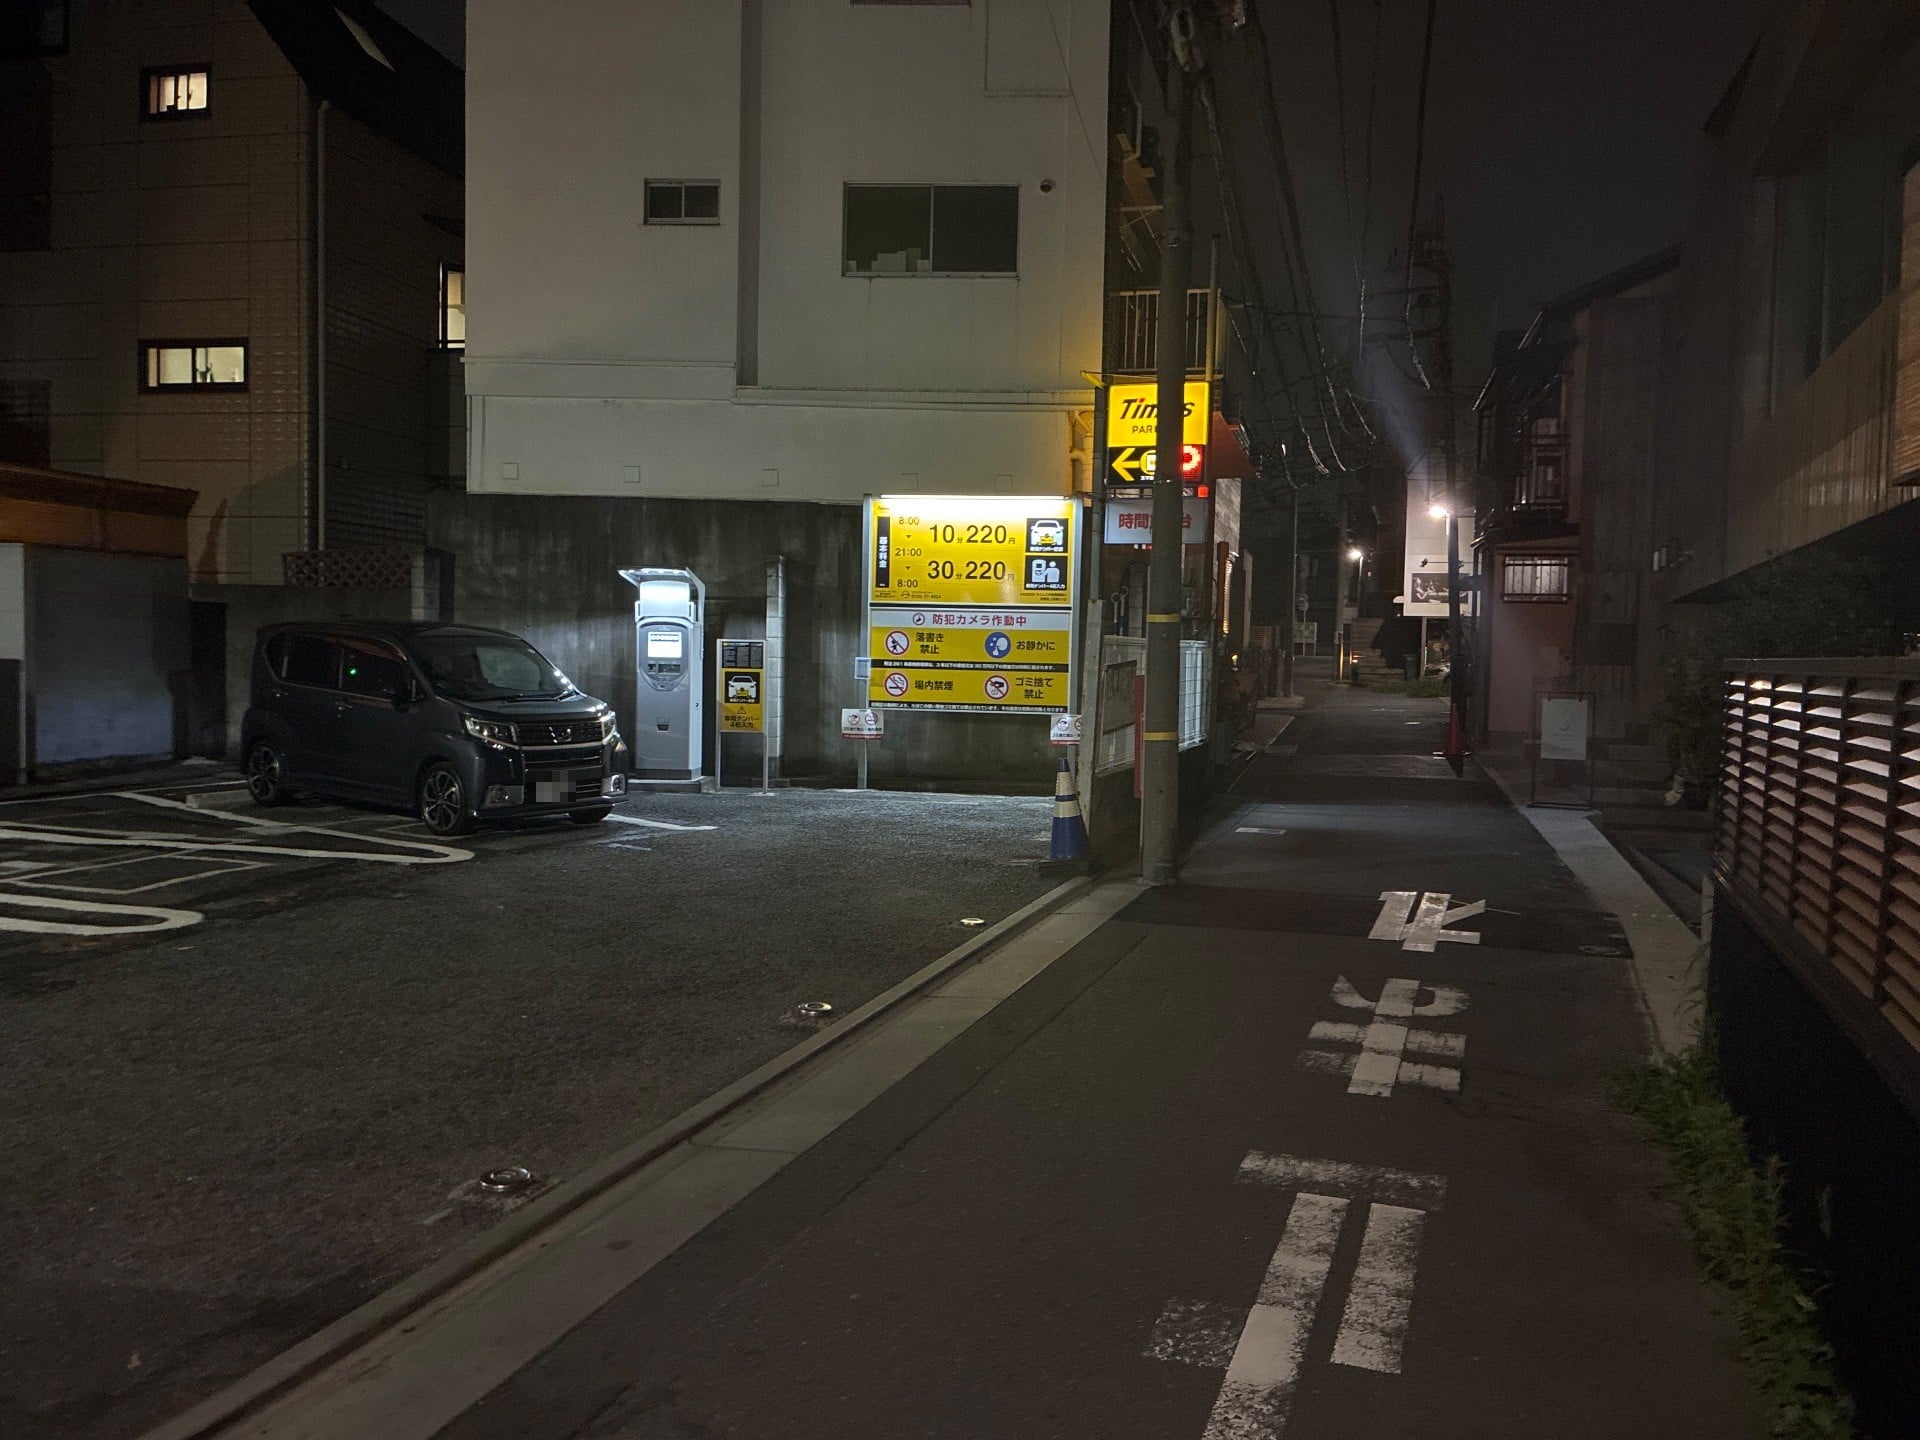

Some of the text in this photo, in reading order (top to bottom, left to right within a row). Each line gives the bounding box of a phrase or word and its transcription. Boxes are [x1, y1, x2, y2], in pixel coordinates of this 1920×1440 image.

[1120, 397, 1196, 420] Tims
[898, 516, 920, 526] 8:00
[1119, 514, 1192, 529] 時間台
[895, 548, 922, 557] 21:00
[897, 579, 919, 588] 8:00
[932, 614, 1028, 626] 防犯カメラ作動中
[915, 632, 945, 643] 落書き
[920, 644, 940, 655] 禁止
[1016, 640, 1056, 651] お静かに
[914, 680, 954, 691] 場内禁煙
[1015, 676, 1054, 687] ゴミ捨て
[1024, 689, 1045, 699] 禁止
